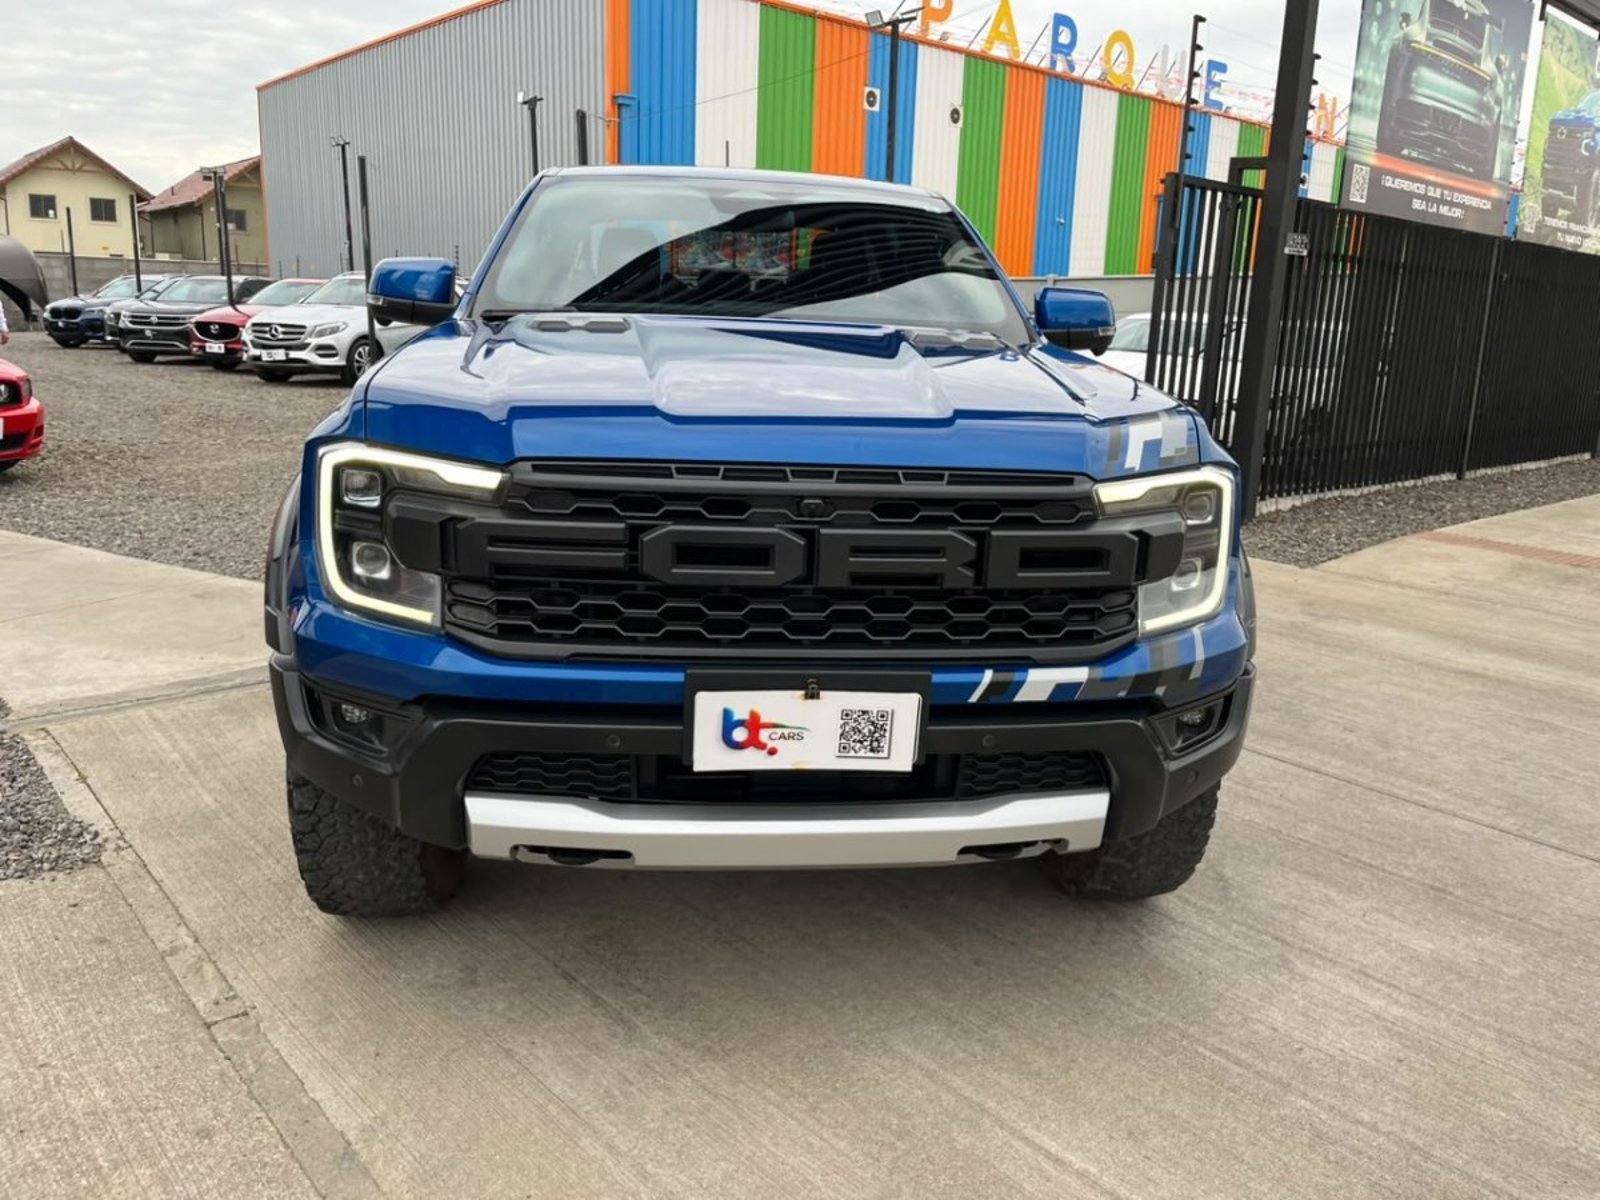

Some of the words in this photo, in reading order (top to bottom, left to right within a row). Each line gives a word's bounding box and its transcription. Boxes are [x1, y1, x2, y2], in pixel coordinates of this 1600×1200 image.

[920, 0, 1228, 110] PARQUE
[1411, 198, 1426, 212] SEA
[1428, 202, 1437, 214] LA
[1427, 184, 1441, 198] QUE
[1443, 188, 1452, 200] TU
[1453, 191, 1492, 210] EXPERIENCIA
[455, 516, 1139, 590] FORD
[768, 731, 805, 742] CARS
